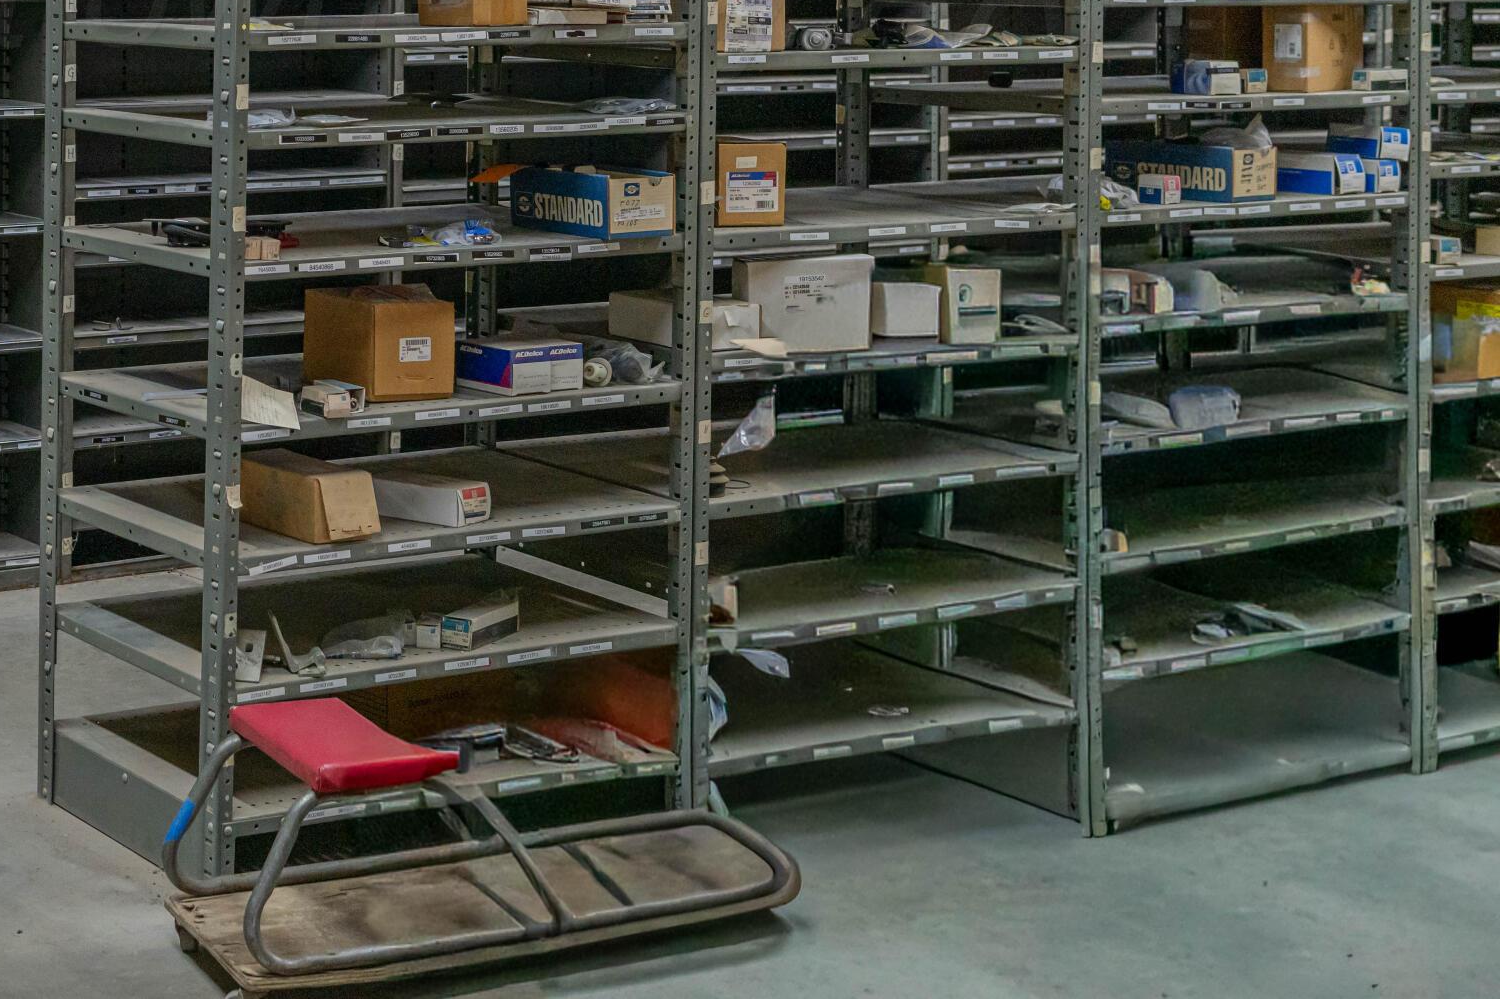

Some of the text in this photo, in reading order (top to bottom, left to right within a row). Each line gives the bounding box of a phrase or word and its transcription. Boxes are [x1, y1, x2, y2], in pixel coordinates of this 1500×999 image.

[534, 192, 604, 228] STANDARD
[515, 349, 544, 358] ACDelco
[550, 347, 578, 355] ACDelco
